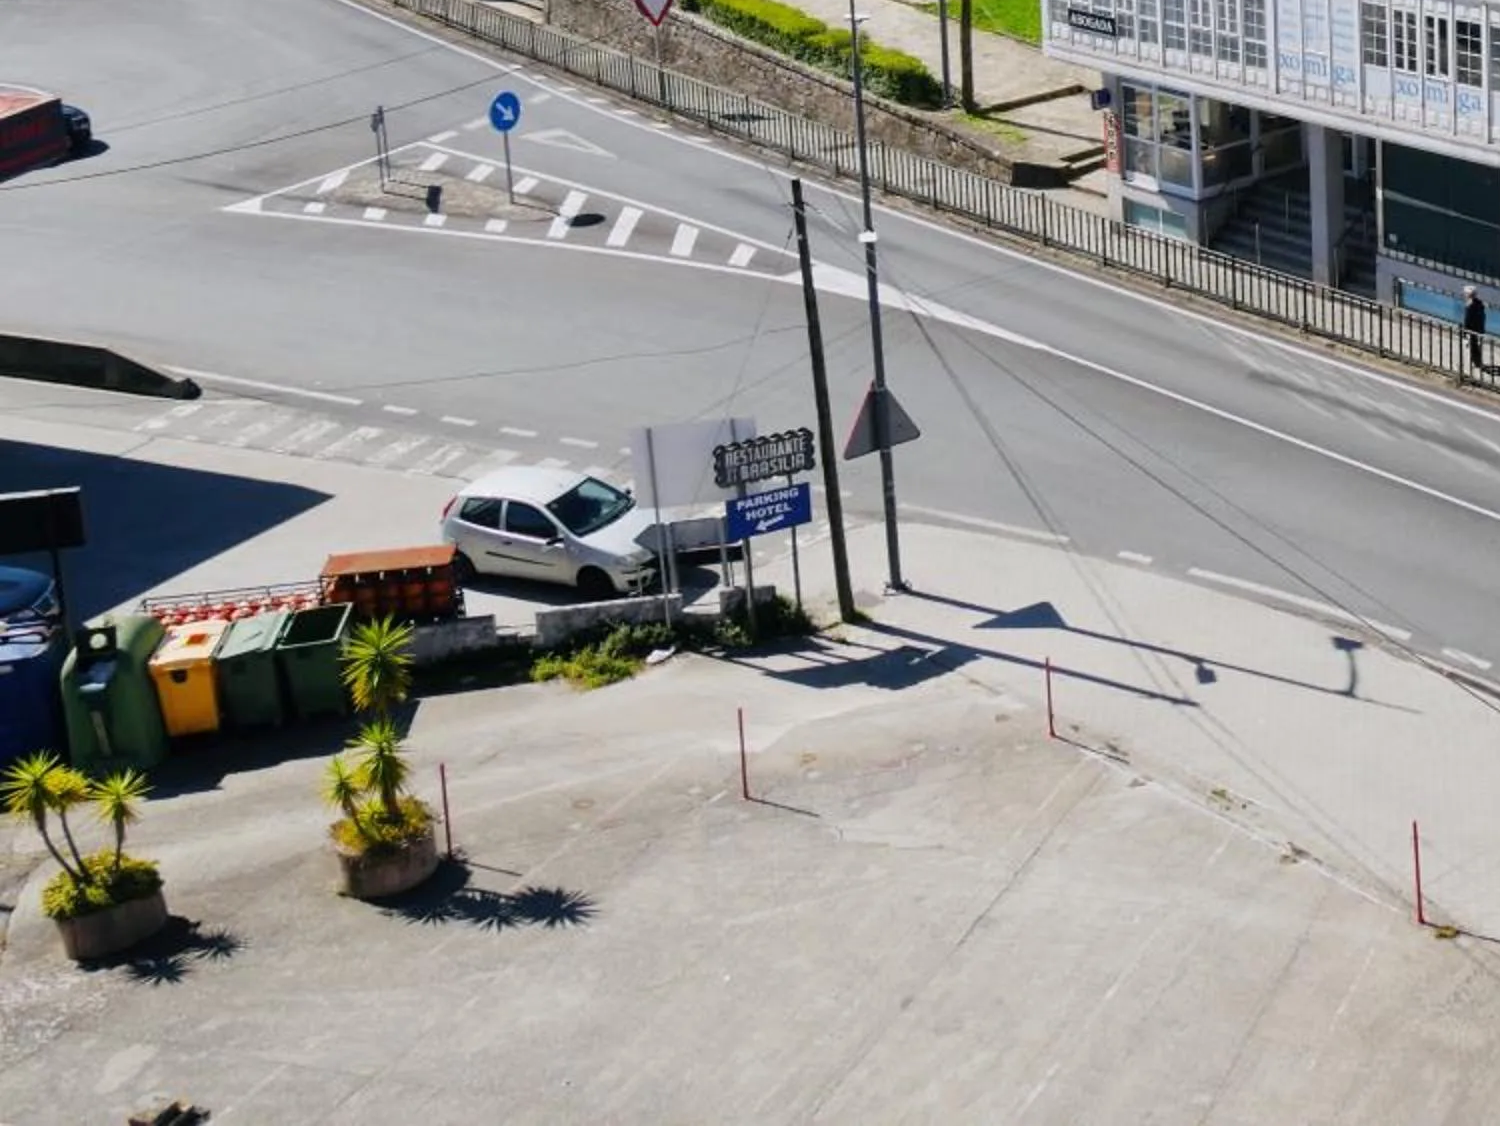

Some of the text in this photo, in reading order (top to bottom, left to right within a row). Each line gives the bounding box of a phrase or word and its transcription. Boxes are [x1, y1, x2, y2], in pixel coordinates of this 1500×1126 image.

[725, 436, 807, 469] RESTAURANTE
[736, 487, 799, 511] PARKING
[745, 501, 793, 521] HOTEL
